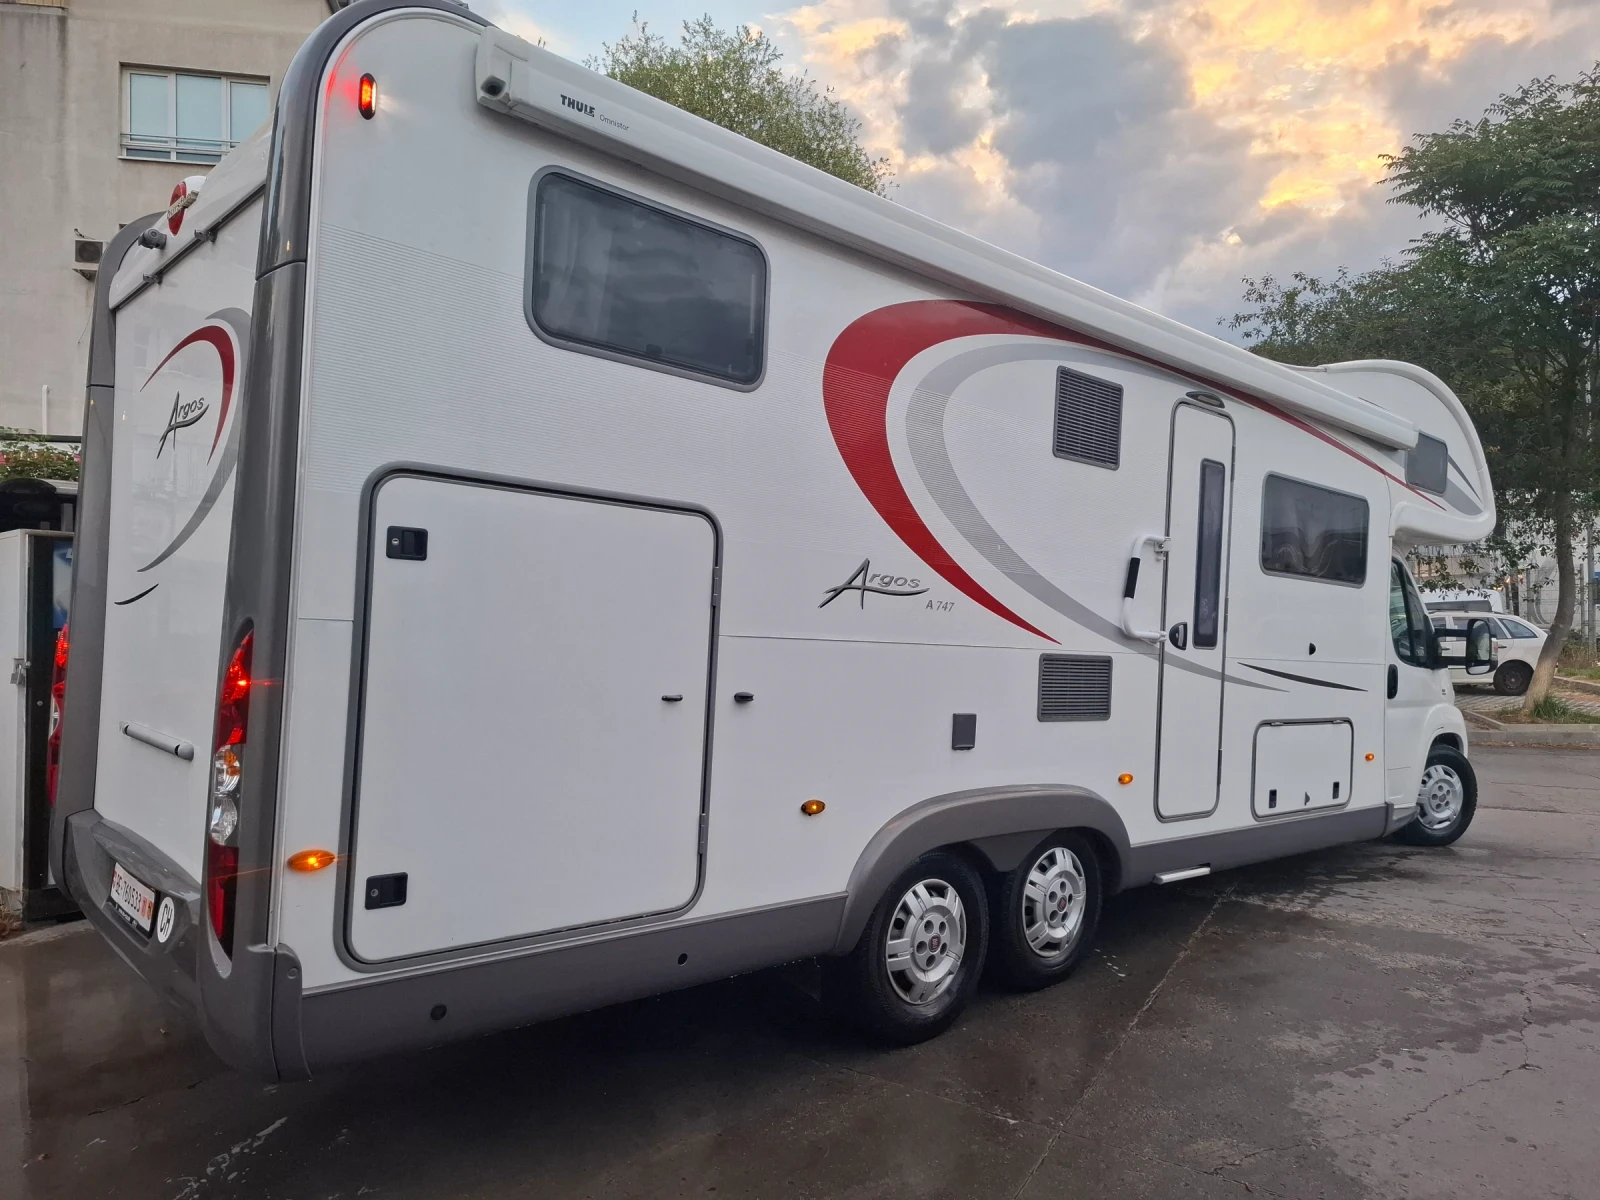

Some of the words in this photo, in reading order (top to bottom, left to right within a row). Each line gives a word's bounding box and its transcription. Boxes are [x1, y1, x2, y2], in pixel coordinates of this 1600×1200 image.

[560, 94, 595, 118] THULE
[599, 114, 630, 131] Omnistor
[156, 390, 210, 460] Argos
[817, 557, 931, 610] Argos
[925, 600, 934, 610] A
[936, 600, 955, 612] 747
[160, 903, 173, 938] CH
